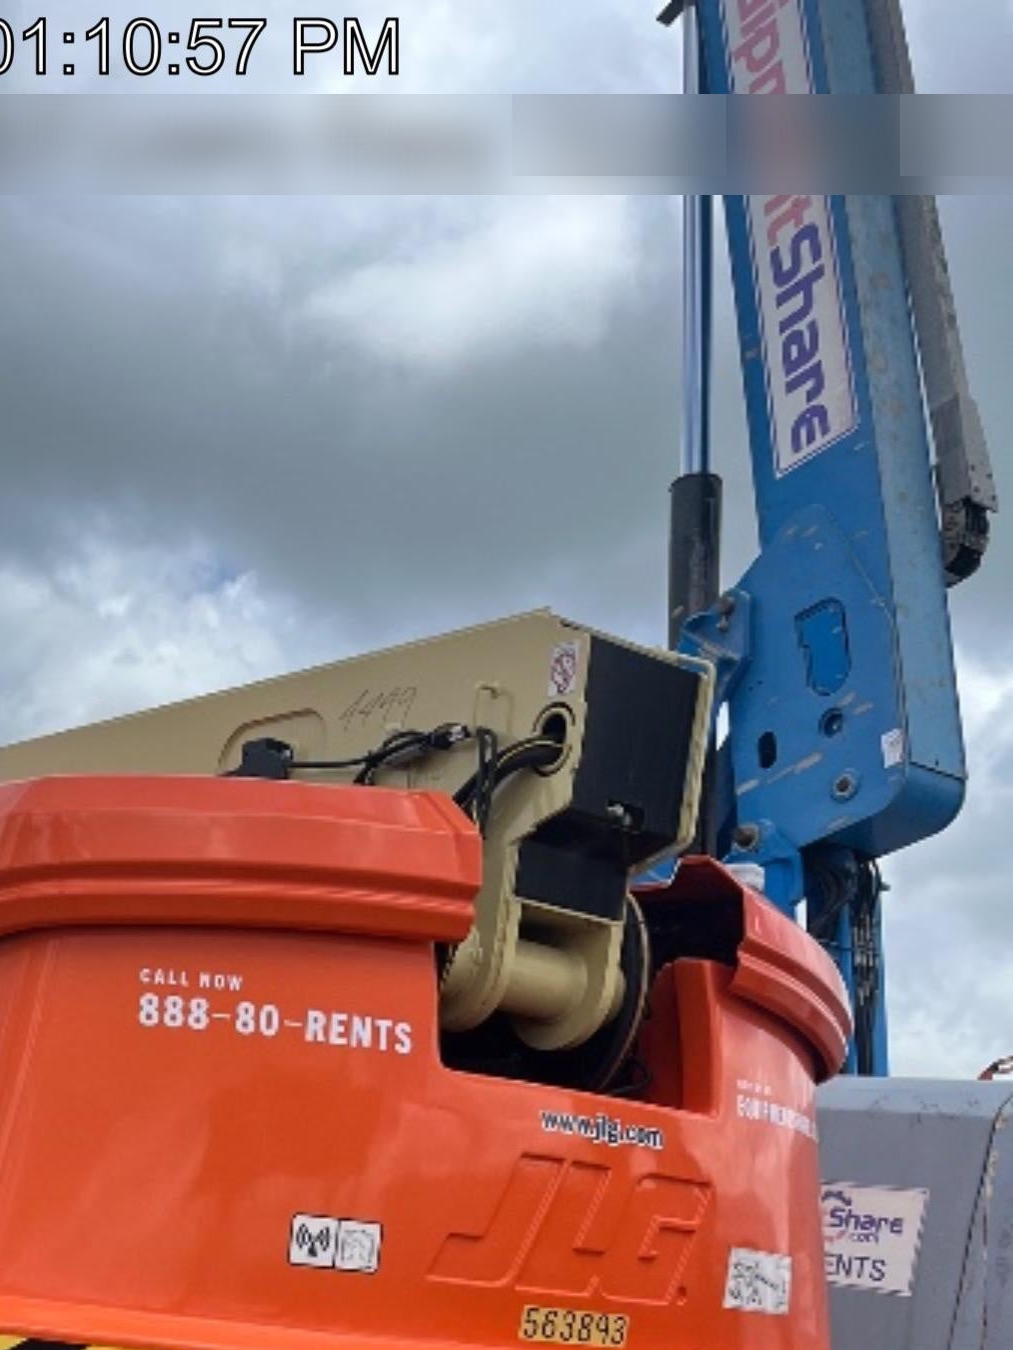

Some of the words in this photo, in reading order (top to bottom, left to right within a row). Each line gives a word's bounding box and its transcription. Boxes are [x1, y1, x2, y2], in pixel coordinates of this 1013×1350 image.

[139, 968, 189, 987] CALL
[199, 971, 243, 992] NOW
[139, 992, 412, 1054] 888-80-RENTS
[425, 1152, 711, 1305] JLG
[828, 1206, 904, 1235] Share
